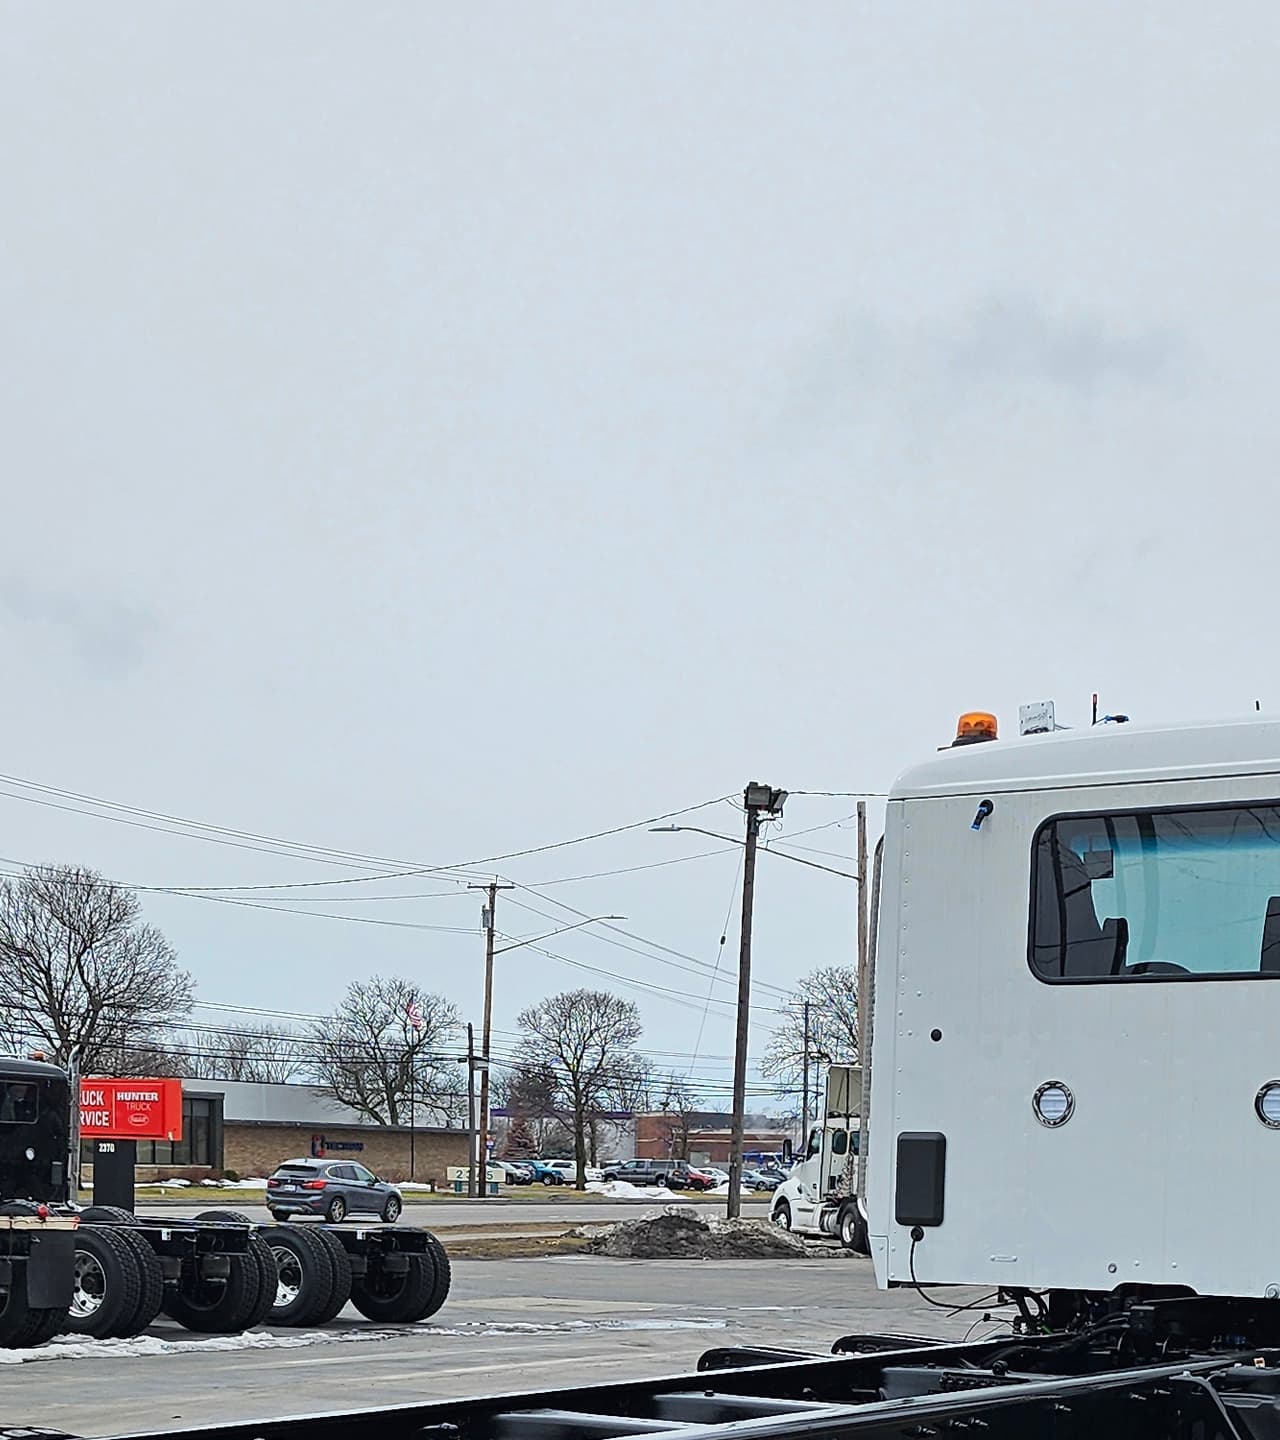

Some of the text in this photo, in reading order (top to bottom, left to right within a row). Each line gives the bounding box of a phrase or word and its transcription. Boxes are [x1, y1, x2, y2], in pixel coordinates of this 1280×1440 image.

[81, 1091, 105, 1106] UCK
[117, 1092, 159, 1102] HUNTER
[125, 1102, 152, 1112] TRUCK
[80, 1111, 110, 1127] RVICE
[98, 1143, 115, 1153] 2370
